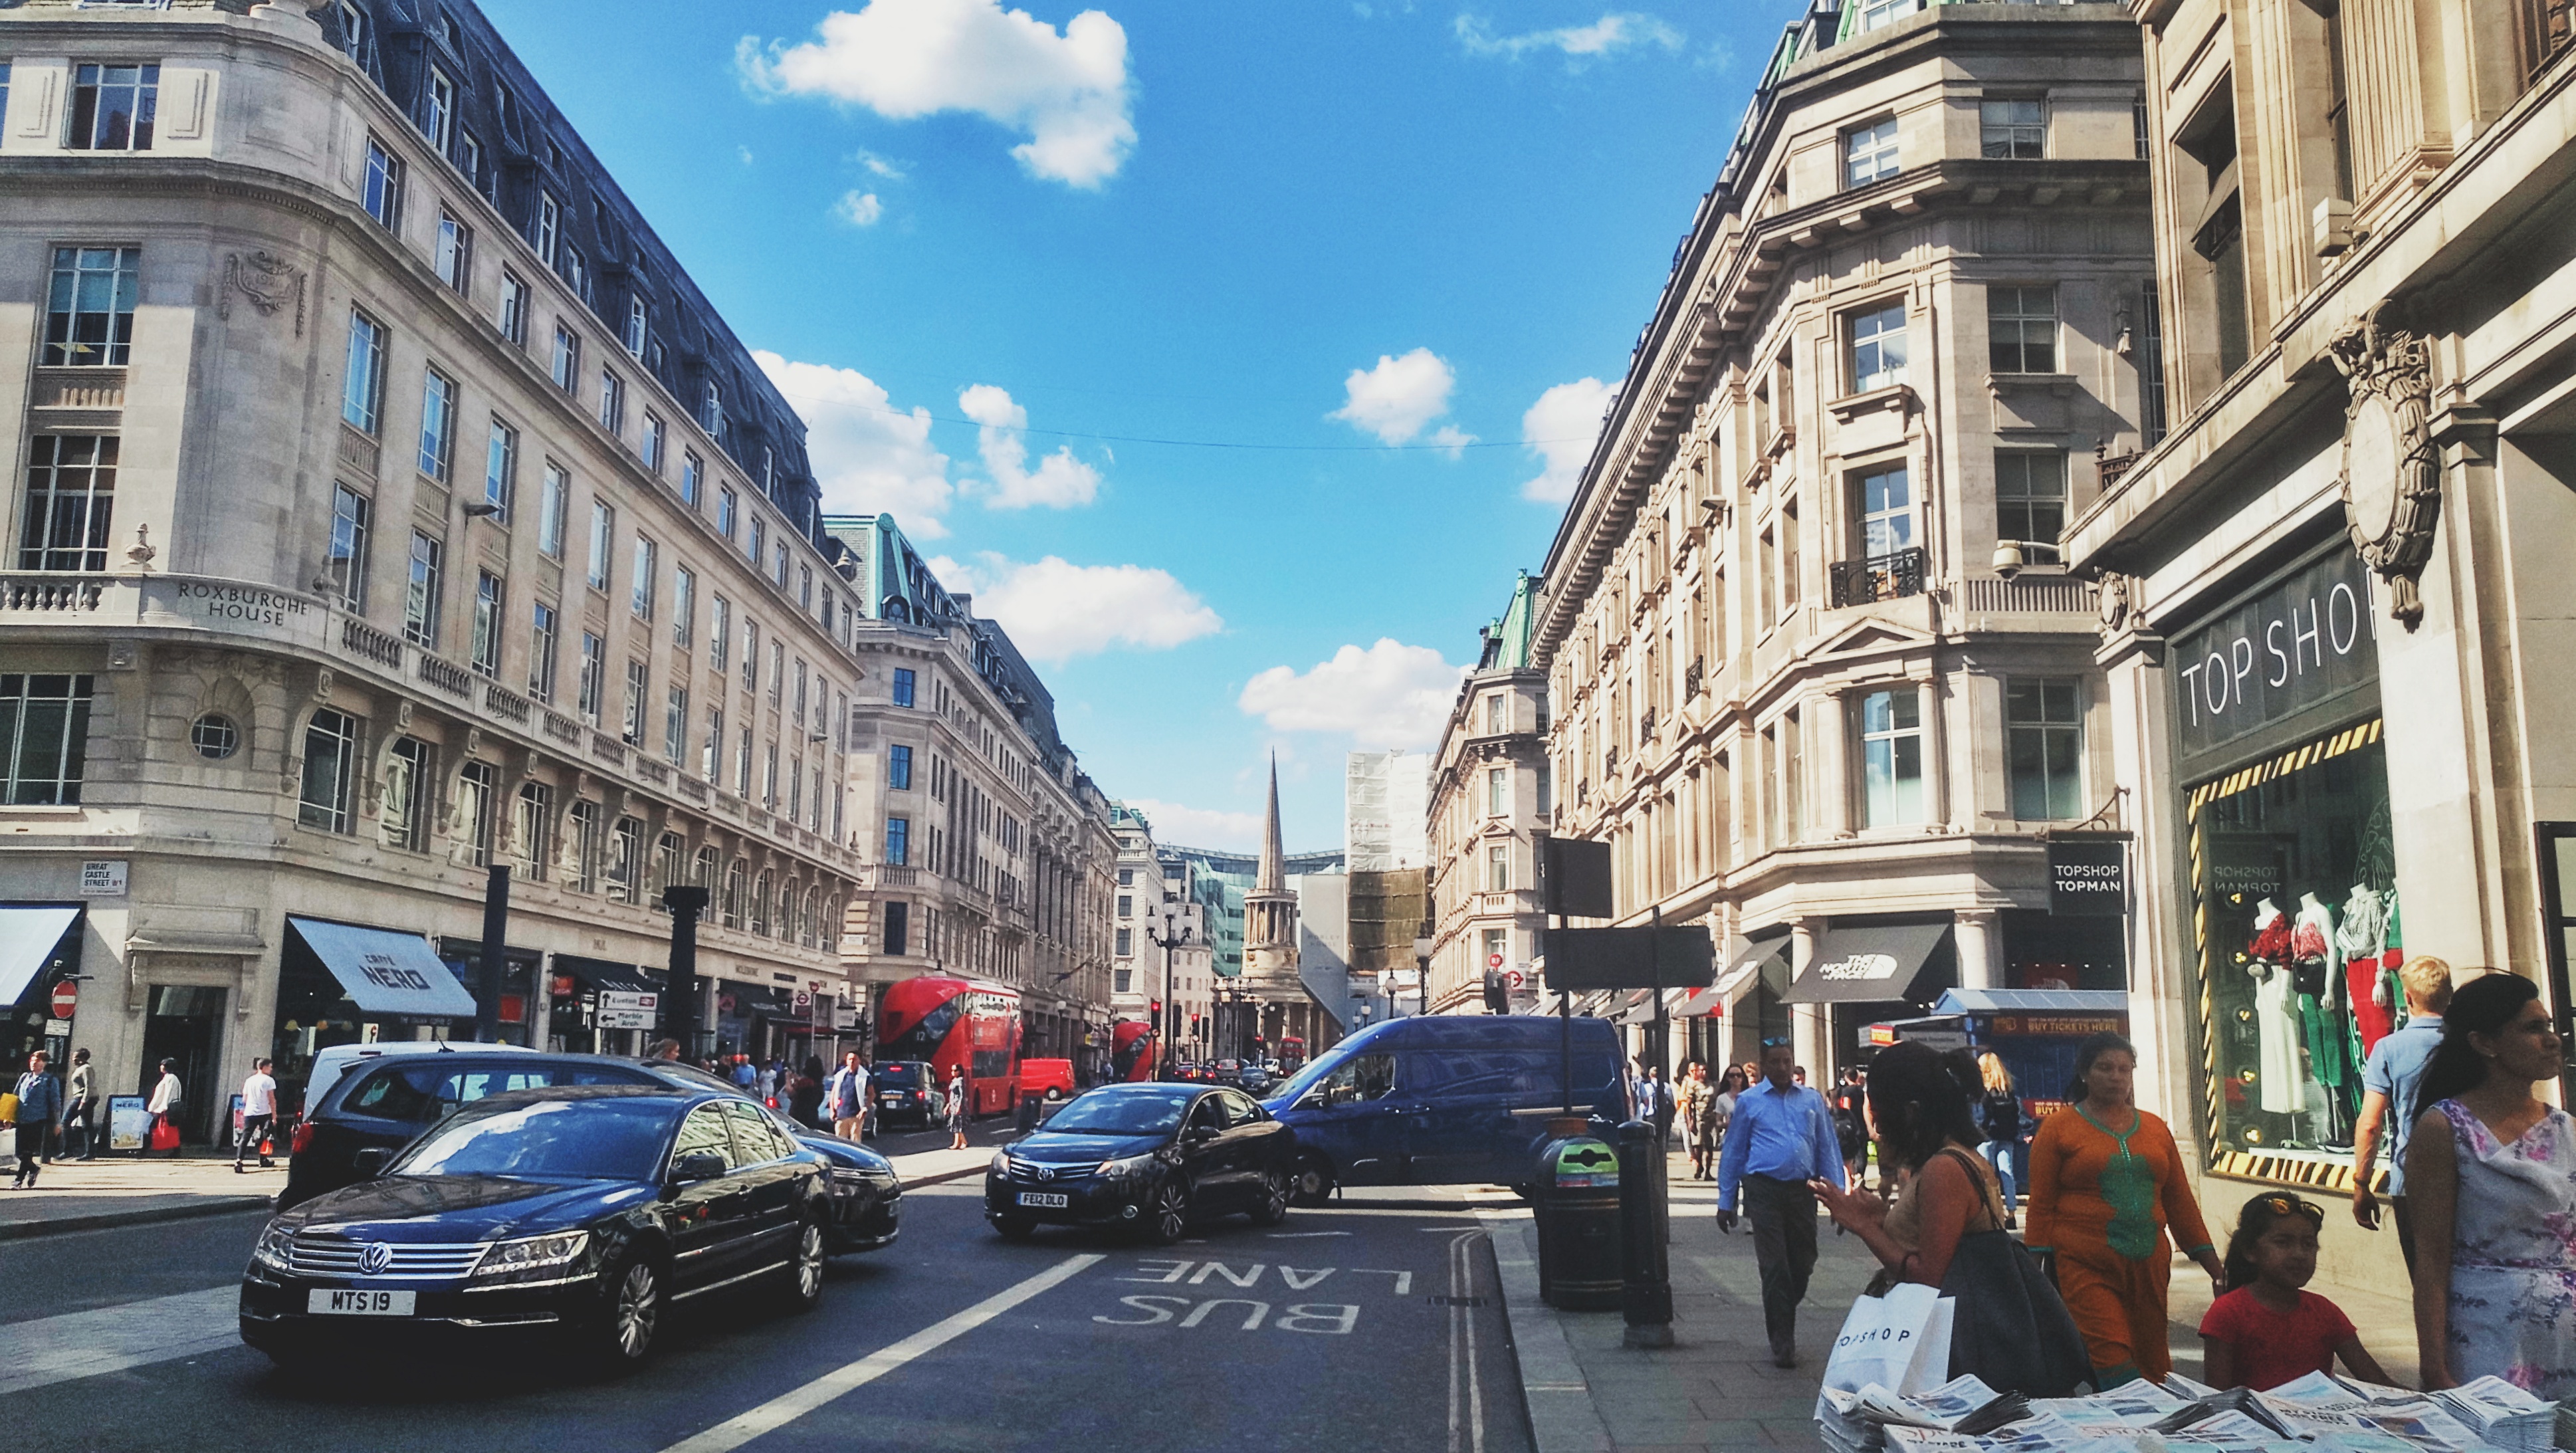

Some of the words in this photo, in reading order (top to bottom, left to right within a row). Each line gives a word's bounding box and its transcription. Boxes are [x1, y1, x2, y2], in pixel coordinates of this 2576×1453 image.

[179, 583, 308, 615] ROXBURGHE
[209, 602, 284, 626] HOUSE
[2054, 865, 2119, 877] TOPSHOP
[2056, 881, 2121, 891] TOPMAN
[359, 964, 431, 989] NERO
[2028, 1022, 2047, 1031] BUY
[2050, 1022, 2089, 1031] TICKETS
[2092, 1022, 2118, 1031] HERE
[1024, 1194, 1044, 1204] FE12
[1113, 1259, 1412, 1294] LANE
[332, 1291, 368, 1310] MTS
[373, 1293, 390, 1311] 19
[1092, 1295, 1360, 1333] BUS
